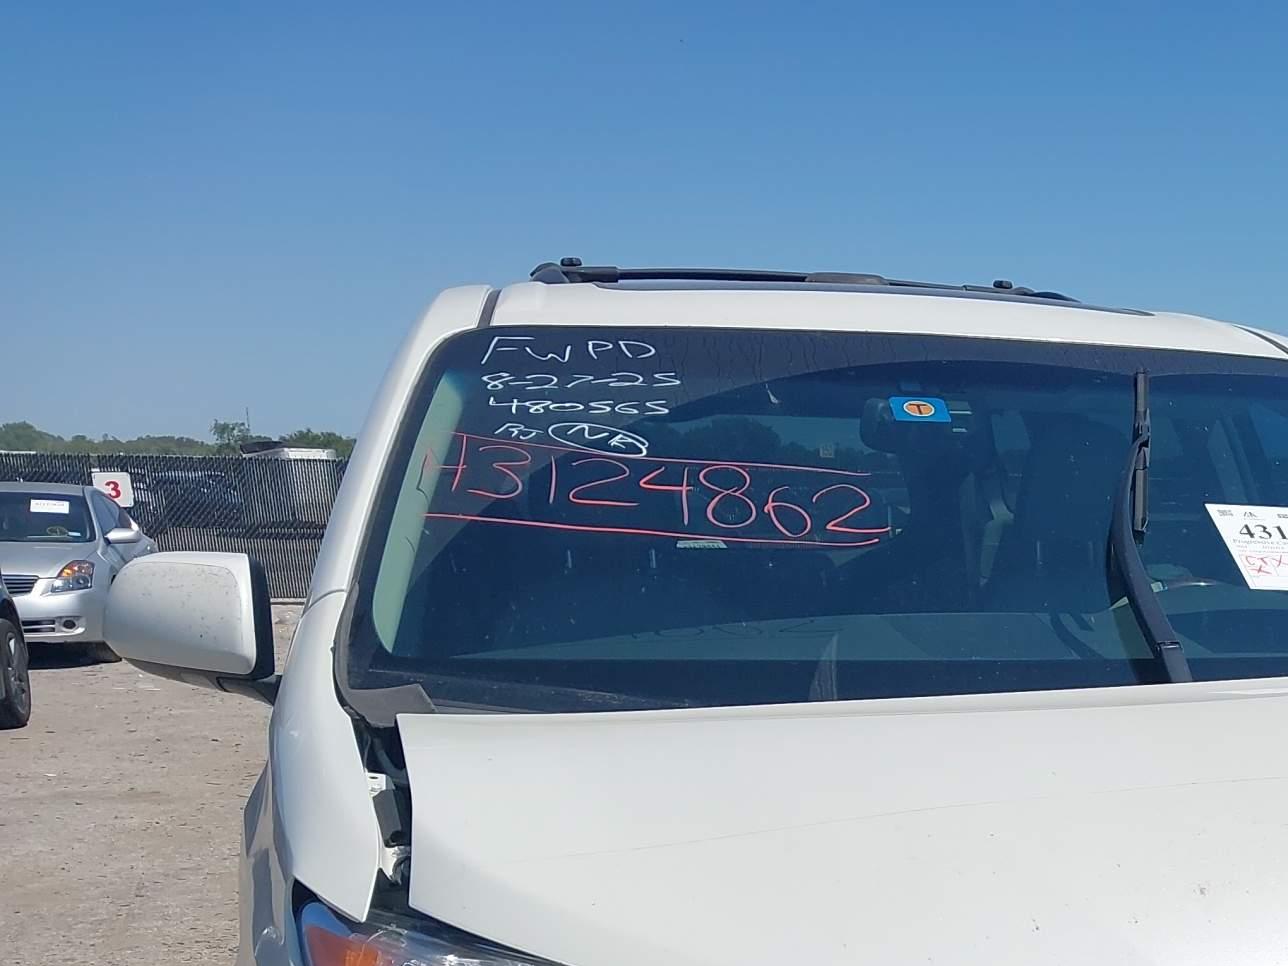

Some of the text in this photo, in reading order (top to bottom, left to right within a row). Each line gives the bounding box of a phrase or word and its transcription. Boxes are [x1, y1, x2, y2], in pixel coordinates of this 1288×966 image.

[481, 372, 681, 390] 8-27-25
[489, 396, 670, 415] 480565
[105, 480, 121, 498] 3
[416, 434, 892, 539] 43124862
